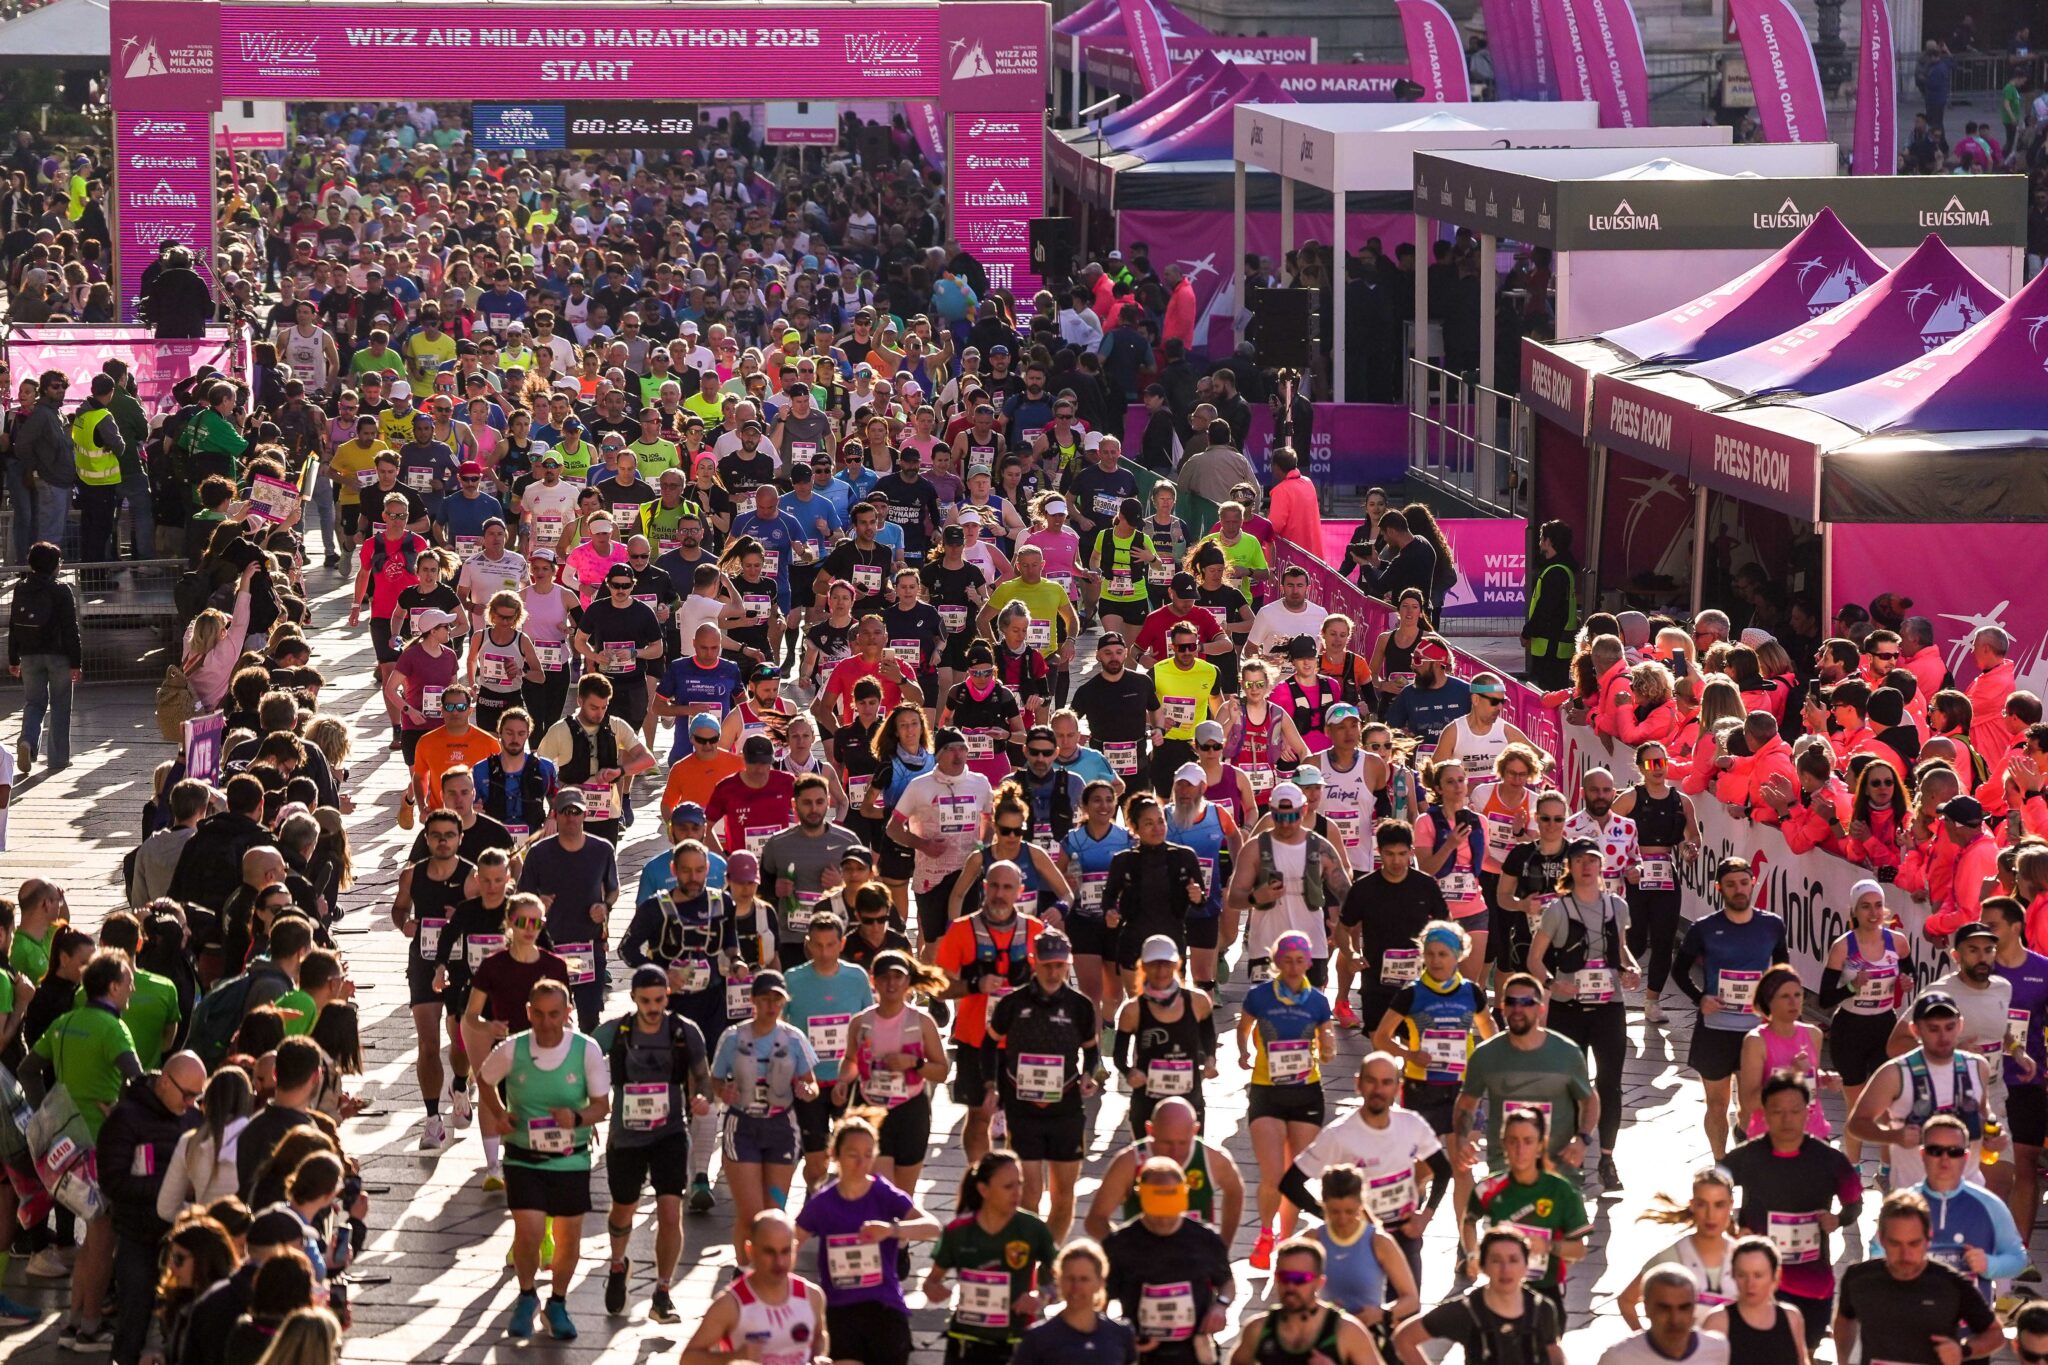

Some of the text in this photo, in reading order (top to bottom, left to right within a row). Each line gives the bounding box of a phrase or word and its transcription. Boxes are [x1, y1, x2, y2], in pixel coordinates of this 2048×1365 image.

[345, 28, 820, 46] WIZZ AIR MILANO MARATHON 2025
[170, 58, 214, 67] MILANO
[541, 60, 634, 80] START
[996, 59, 1038, 67] MILANO
[1281, 78, 1409, 91] ANO MARATH
[485, 127, 550, 140] FESTINA
[572, 119, 694, 134] 00:24:50
[1590, 213, 1660, 231] LEVISSIMA
[1753, 212, 1819, 229] LEVISSIM
[1920, 210, 1990, 227] LEVISSIMA
[1532, 360, 1572, 412] PRESS ROOM
[1610, 396, 1672, 450] PRESS ROOM
[1714, 434, 1790, 493] PRESS ROOM
[1484, 591, 1525, 602] MARA
[1463, 754, 1489, 762] 25K
[1324, 785, 1360, 801] Taipei
[1771, 864, 1849, 963] UniCre
